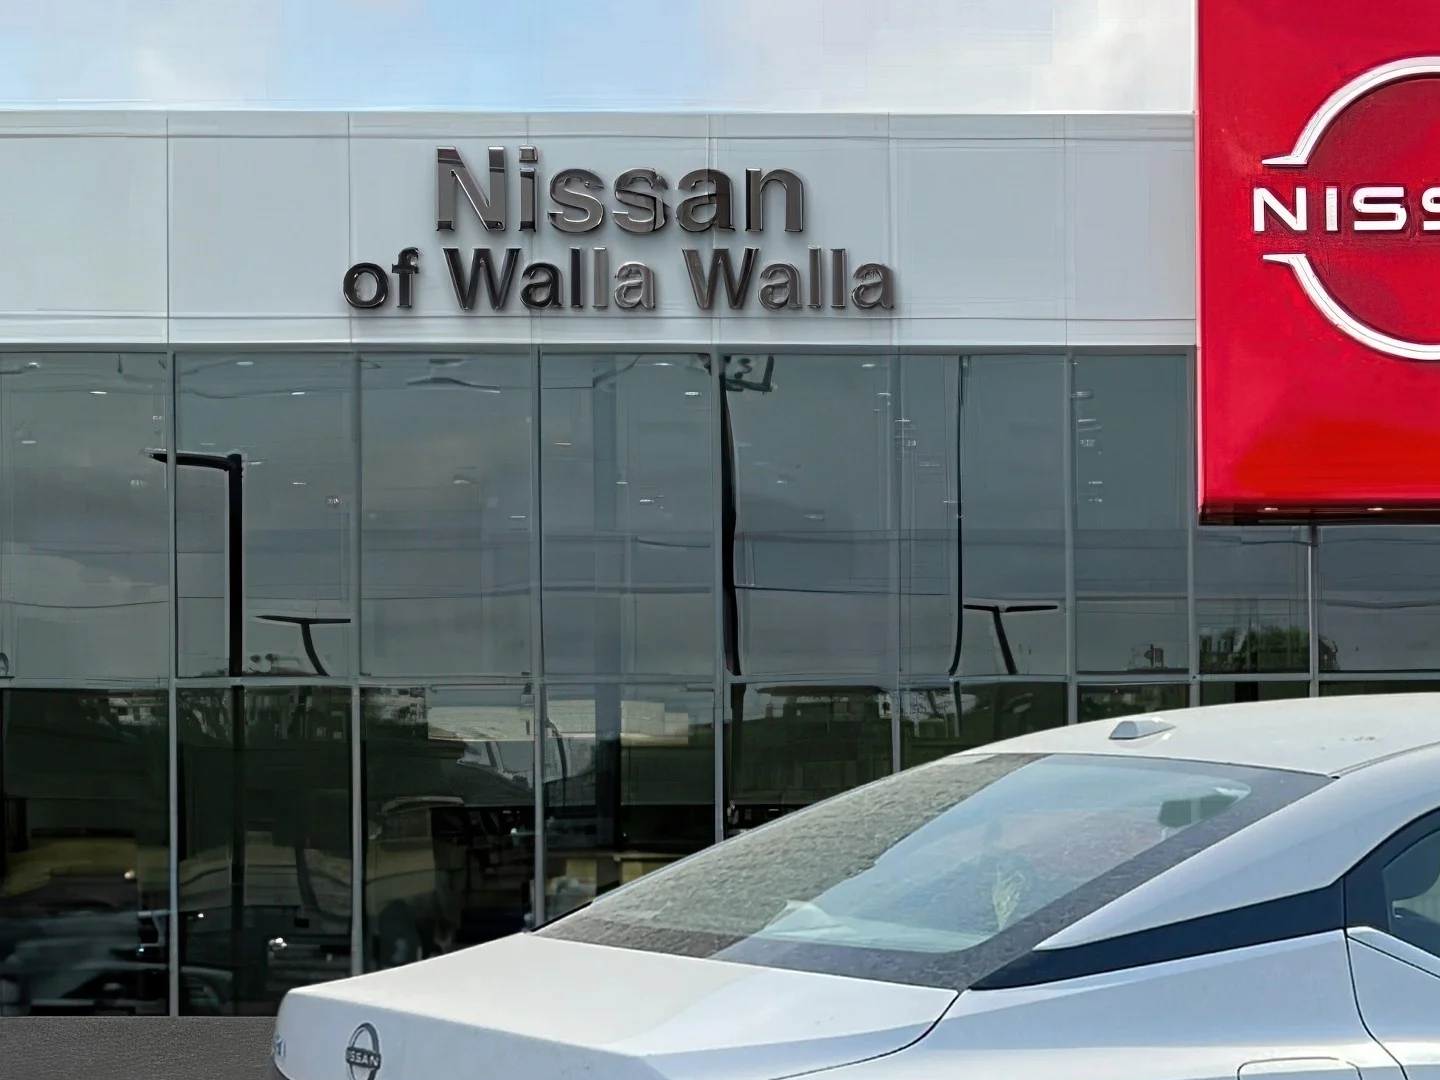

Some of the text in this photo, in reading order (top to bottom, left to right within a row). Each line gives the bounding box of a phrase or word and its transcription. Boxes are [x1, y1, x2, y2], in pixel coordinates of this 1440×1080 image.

[436, 145, 804, 232] Nissan
[342, 247, 895, 310] of Walla Walla
